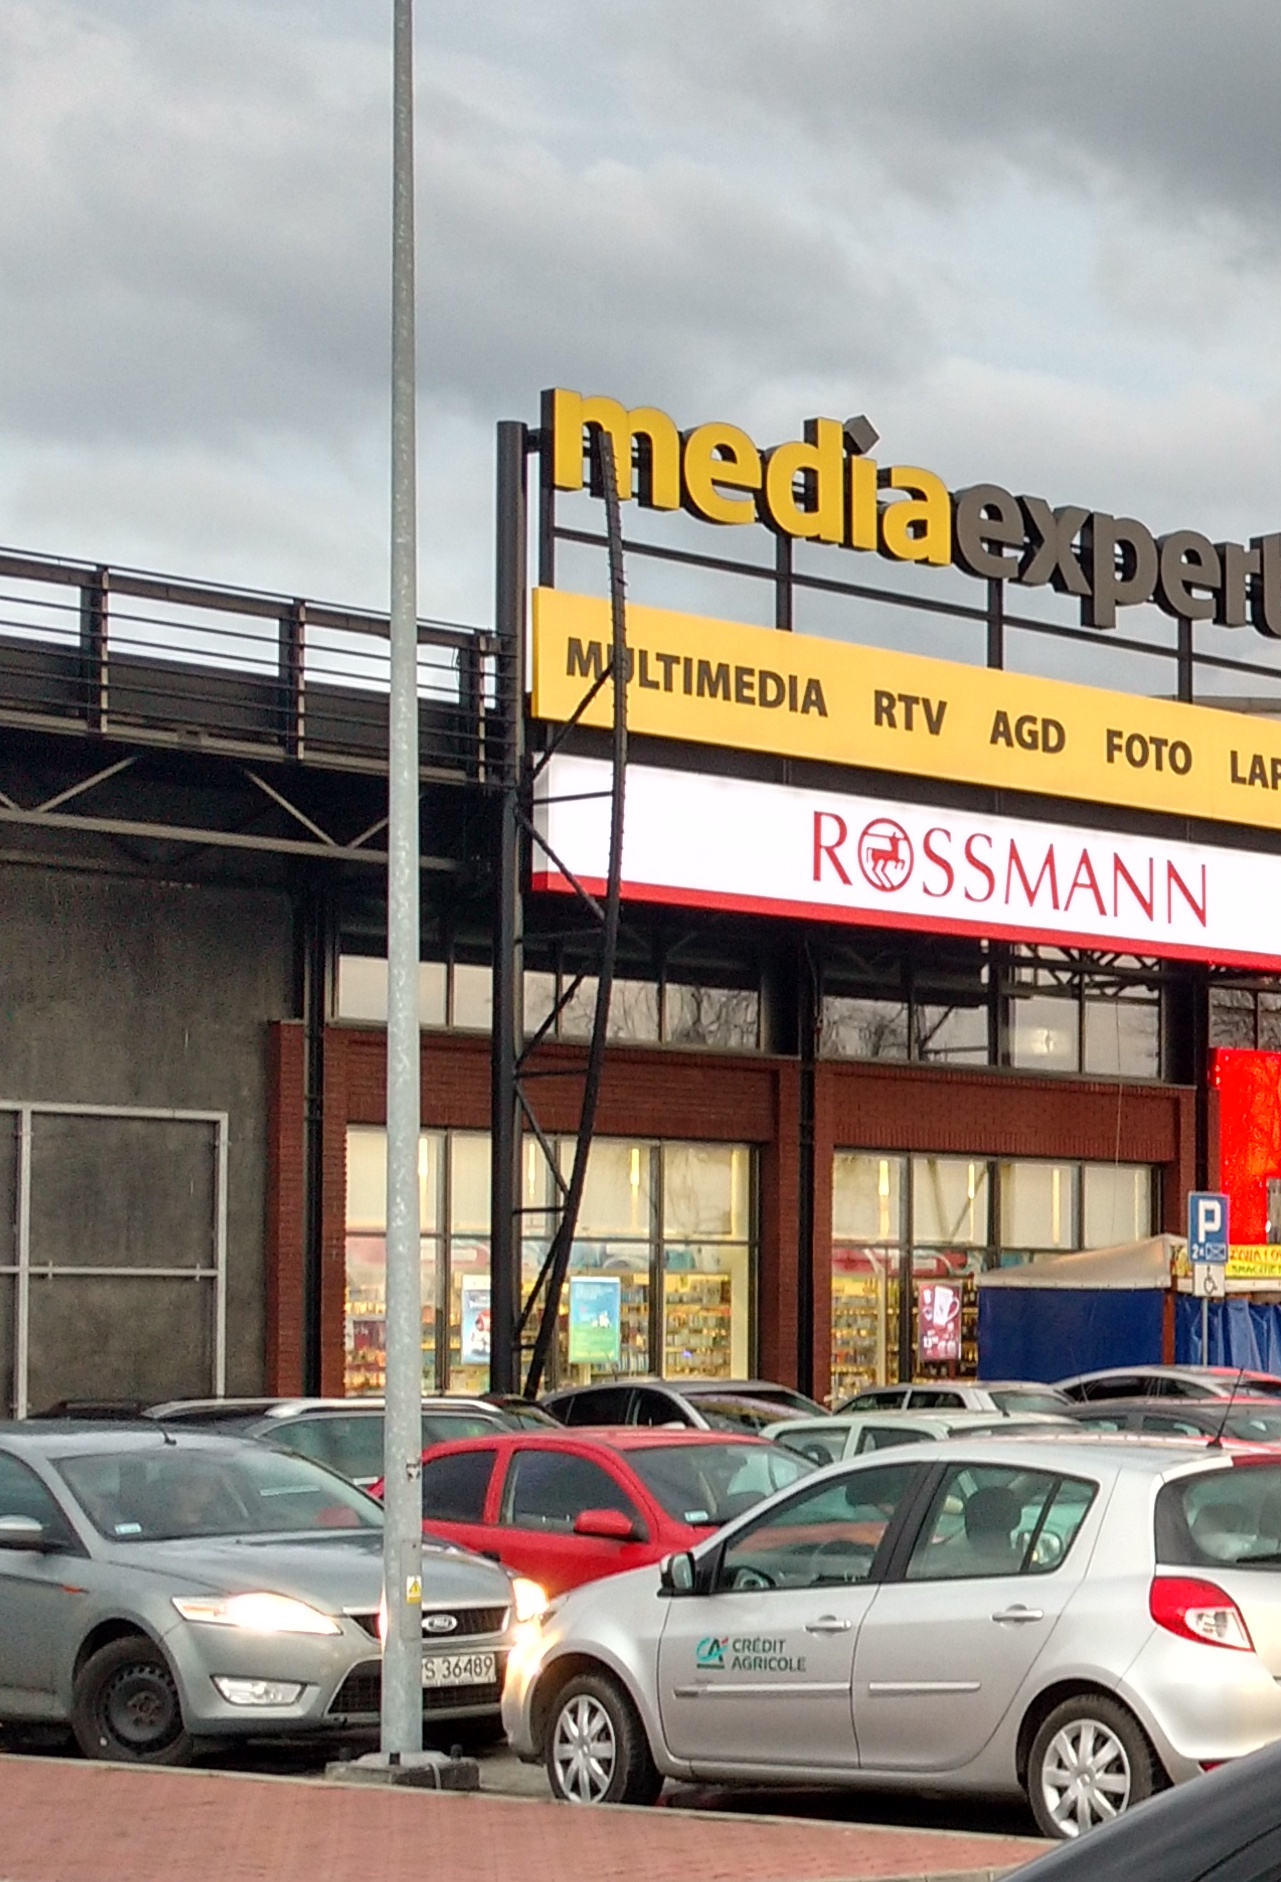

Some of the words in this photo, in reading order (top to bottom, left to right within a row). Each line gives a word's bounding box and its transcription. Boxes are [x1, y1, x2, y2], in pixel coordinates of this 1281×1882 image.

[566, 636, 828, 717] MULTIMEDIA
[873, 690, 947, 735] RTV
[989, 710, 1066, 755] AGD
[1105, 728, 1193, 777] FOTO
[813, 810, 1208, 928] ROSSMANN
[1198, 1199, 1222, 1243] P
[732, 1636, 786, 1654] CRÉDIT
[441, 1654, 494, 1681] 36489
[731, 1655, 807, 1672] AGRICOLE
